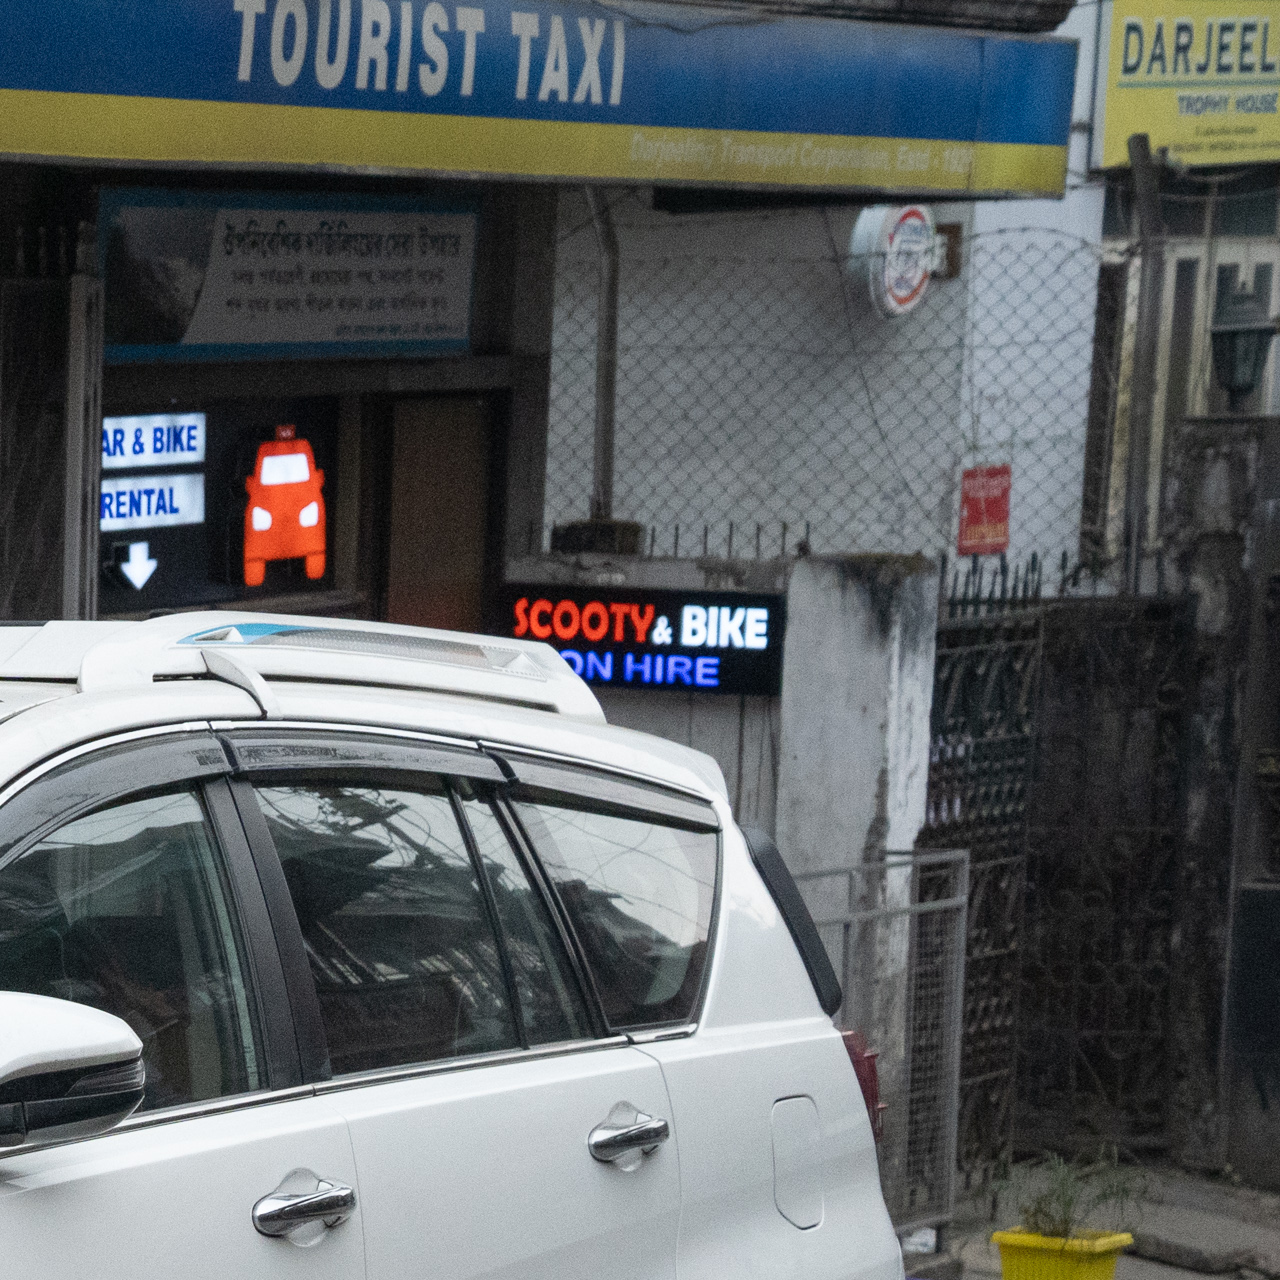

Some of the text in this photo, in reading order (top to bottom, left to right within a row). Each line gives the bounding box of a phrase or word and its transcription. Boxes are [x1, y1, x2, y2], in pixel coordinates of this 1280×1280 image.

[234, 0, 626, 106] TOURIST TAXI
[102, 425, 197, 456] AR & BIKE
[100, 487, 179, 519] RENTAL
[513, 597, 768, 650] SCOOTY & BIKE
[623, 652, 720, 687] HIRE
